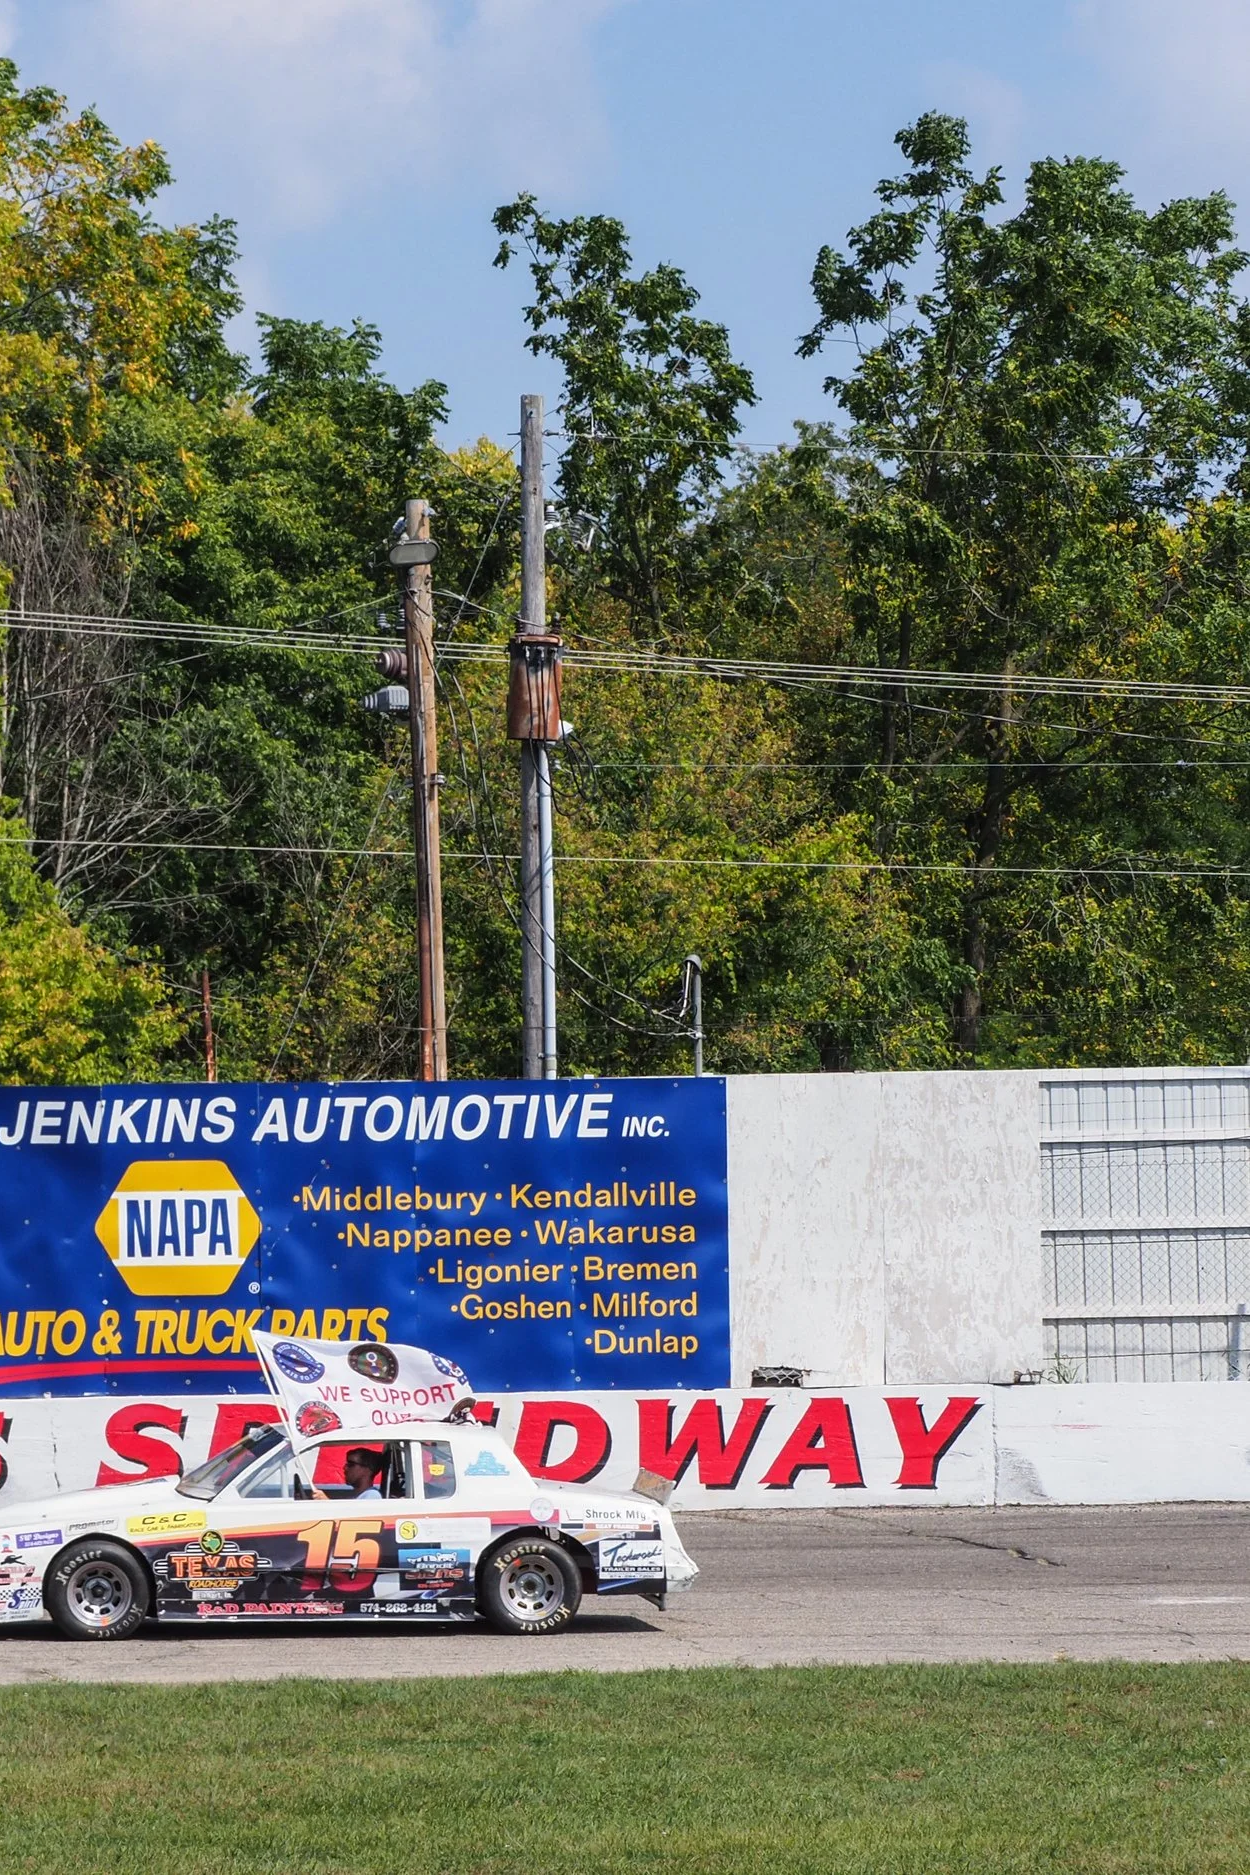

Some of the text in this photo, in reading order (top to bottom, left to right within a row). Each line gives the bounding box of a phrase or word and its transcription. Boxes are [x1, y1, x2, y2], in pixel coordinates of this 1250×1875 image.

[251, 1093, 614, 1143] AUTOMOTIVE
[621, 1115, 670, 1138] INC.
[301, 1182, 697, 1216] Middlebury Kendallville
[126, 1197, 233, 1258] NAPA
[346, 1219, 696, 1253] Nappanee Wakarusa
[437, 1256, 697, 1290] Ligonier Bremen
[459, 1291, 698, 1320] Goshen Milford
[92, 1309, 123, 1356] &
[135, 1308, 264, 1355] TRUCK
[594, 1329, 699, 1359] Dunlap
[317, 1383, 456, 1406] WE SUPPORT
[142, 1516, 156, 1525] C
[173, 1513, 188, 1522] C
[585, 1508, 622, 1519] Shrock
[55, 1549, 103, 1587] Hoosier
[171, 1554, 255, 1578] TEXAS
[297, 1519, 385, 1593] 15
[494, 1545, 546, 1573] Hoosier
[188, 1579, 239, 1588] ROADHOUSE
